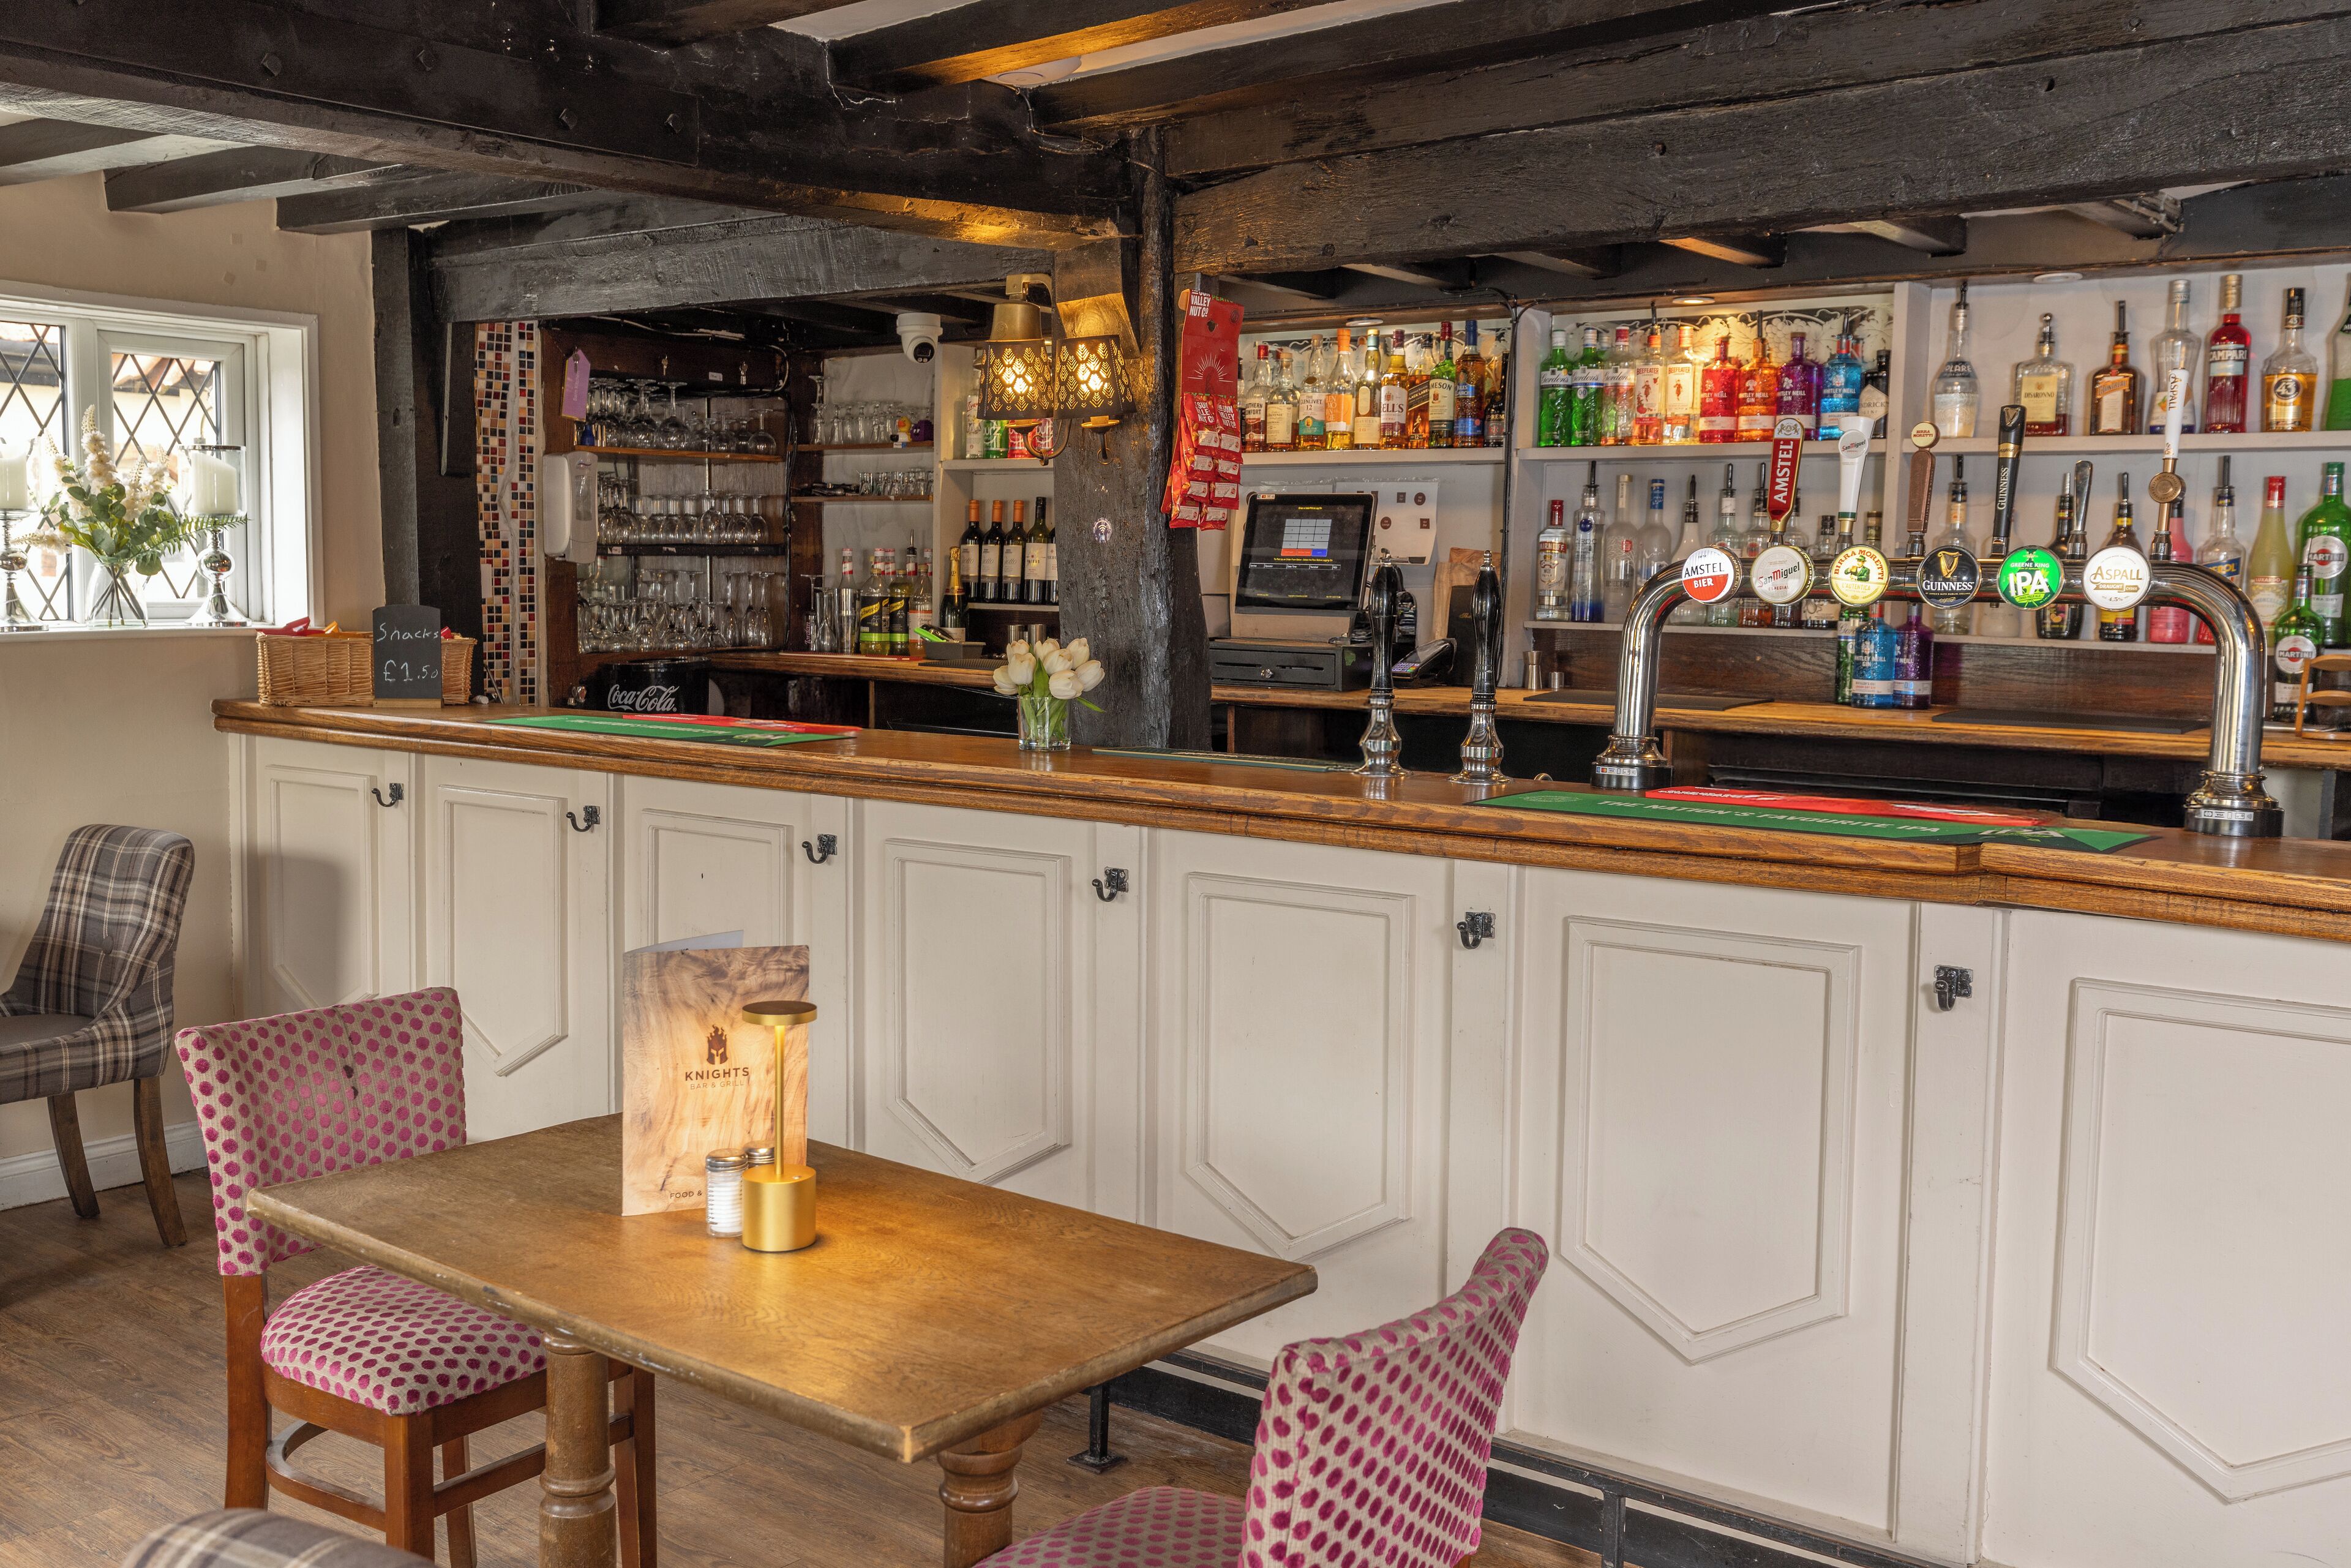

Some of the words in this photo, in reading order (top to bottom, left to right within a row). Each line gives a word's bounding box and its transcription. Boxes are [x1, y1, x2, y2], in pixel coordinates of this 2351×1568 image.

[1191, 294, 1211, 307] VALLEY
[1189, 306, 1202, 317] NUT
[2209, 350, 2248, 361] CAMPARI
[1541, 372, 1569, 383] Gordon's
[1572, 370, 1599, 382] Gordon's
[1603, 371, 1631, 383] Gordon's
[1668, 366, 1690, 375] BEEFEATER
[1430, 382, 1452, 391] MESON
[2169, 373, 2182, 411] ASPALL
[2276, 380, 2296, 395] 43
[2024, 391, 2055, 399] DISARONNO
[1773, 441, 1794, 505] AMSTEL
[1997, 467, 2009, 511] GUINNESS
[1684, 562, 1725, 579] AMSTEL
[1834, 550, 1856, 575] BIRRA
[1858, 549, 1884, 580] MORETTI
[2090, 565, 2143, 584] ASPALL
[1693, 577, 1714, 588] BIER
[1923, 580, 1974, 591] GUINNESS
[2008, 570, 2051, 597] IPA
[376, 622, 439, 642] Snacks
[607, 684, 677, 711] Coca-Cola
[1643, 805, 1755, 816] NATION'S
[1756, 814, 1895, 828] FAVOURITE
[684, 1067, 750, 1081] KNIGHTS
